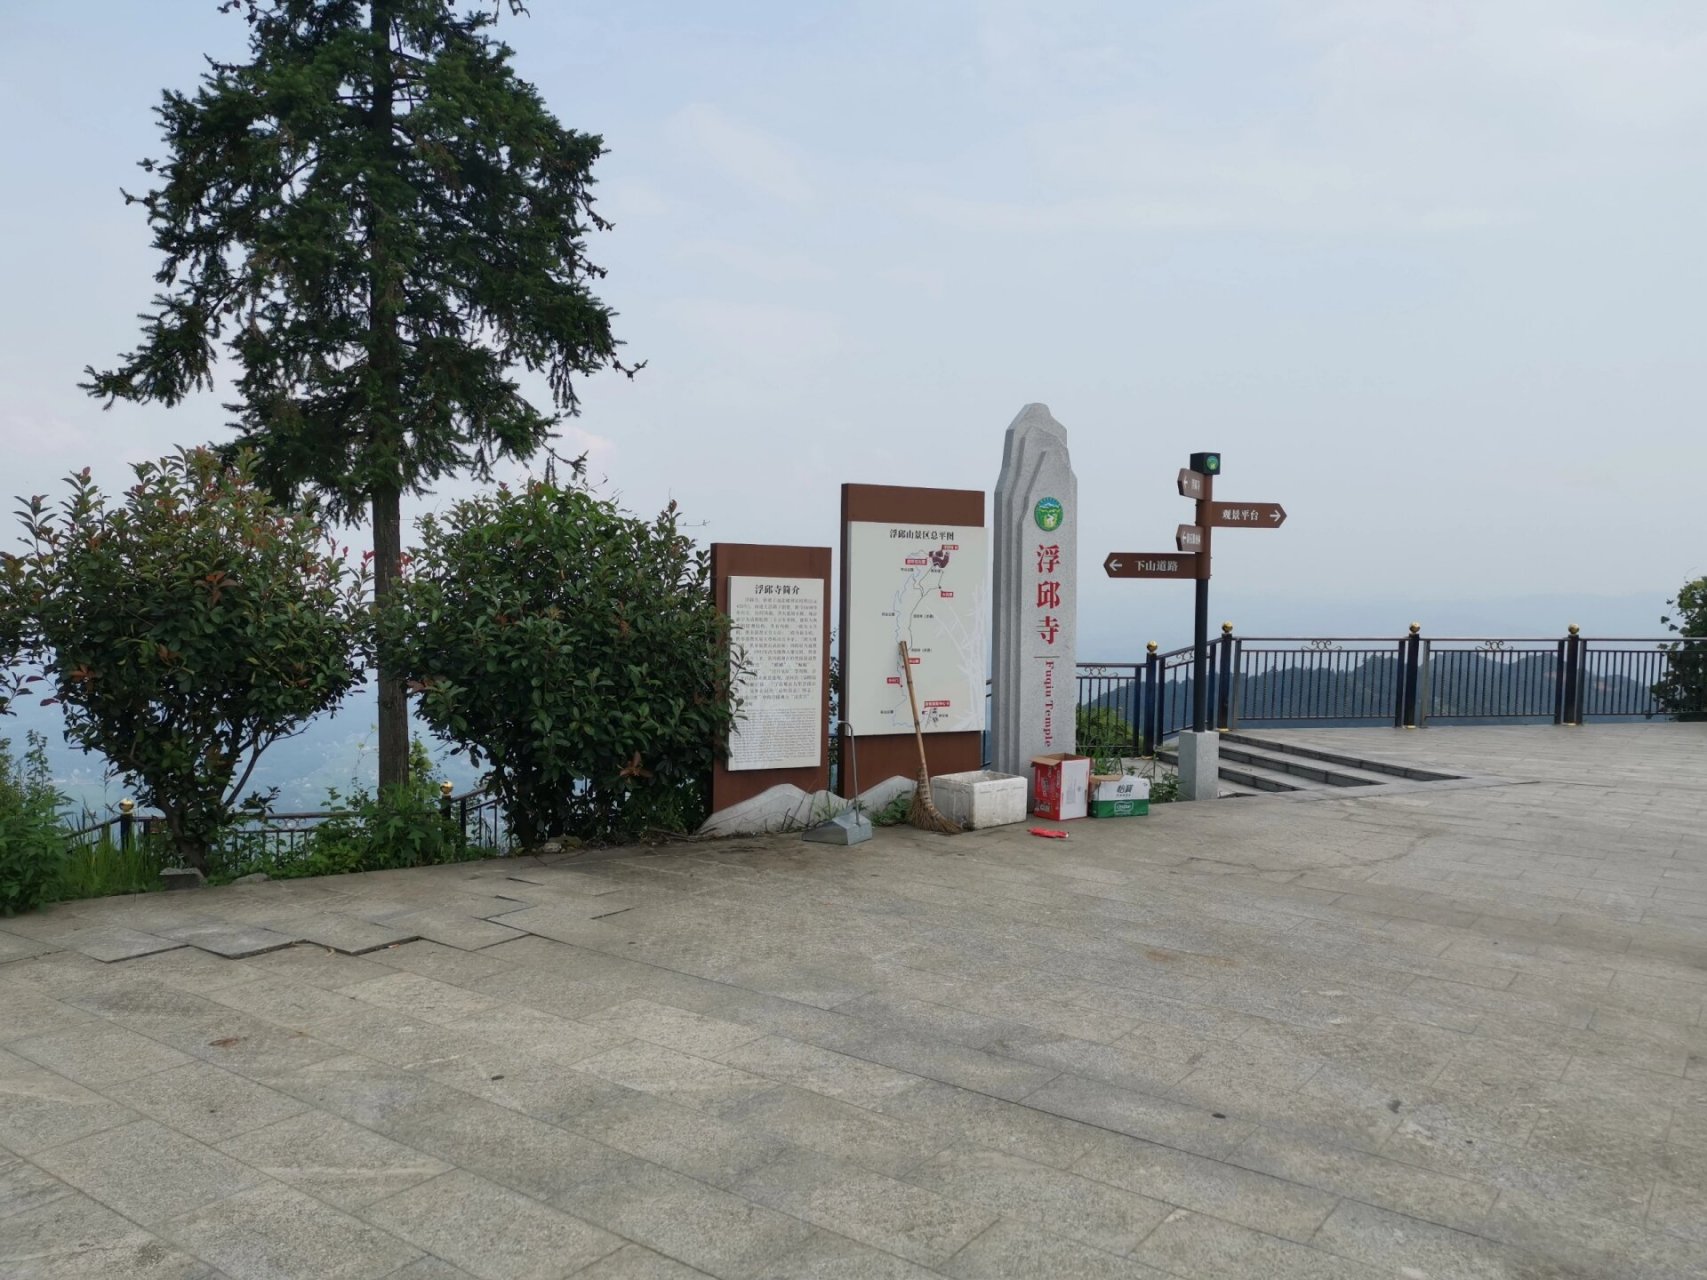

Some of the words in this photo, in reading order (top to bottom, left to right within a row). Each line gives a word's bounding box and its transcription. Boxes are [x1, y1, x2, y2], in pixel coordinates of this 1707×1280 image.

[1222, 509, 1259, 521] 观景平台
[890, 529, 955, 541] 浮邱山景区总平图
[1135, 560, 1178, 572] 下山道路
[755, 584, 800, 595] 浮邱寺简介
[1036, 544, 1061, 645] 浮邱寺
[1043, 661, 1054, 697] Fuqiu
[1043, 700, 1054, 747] Temple
